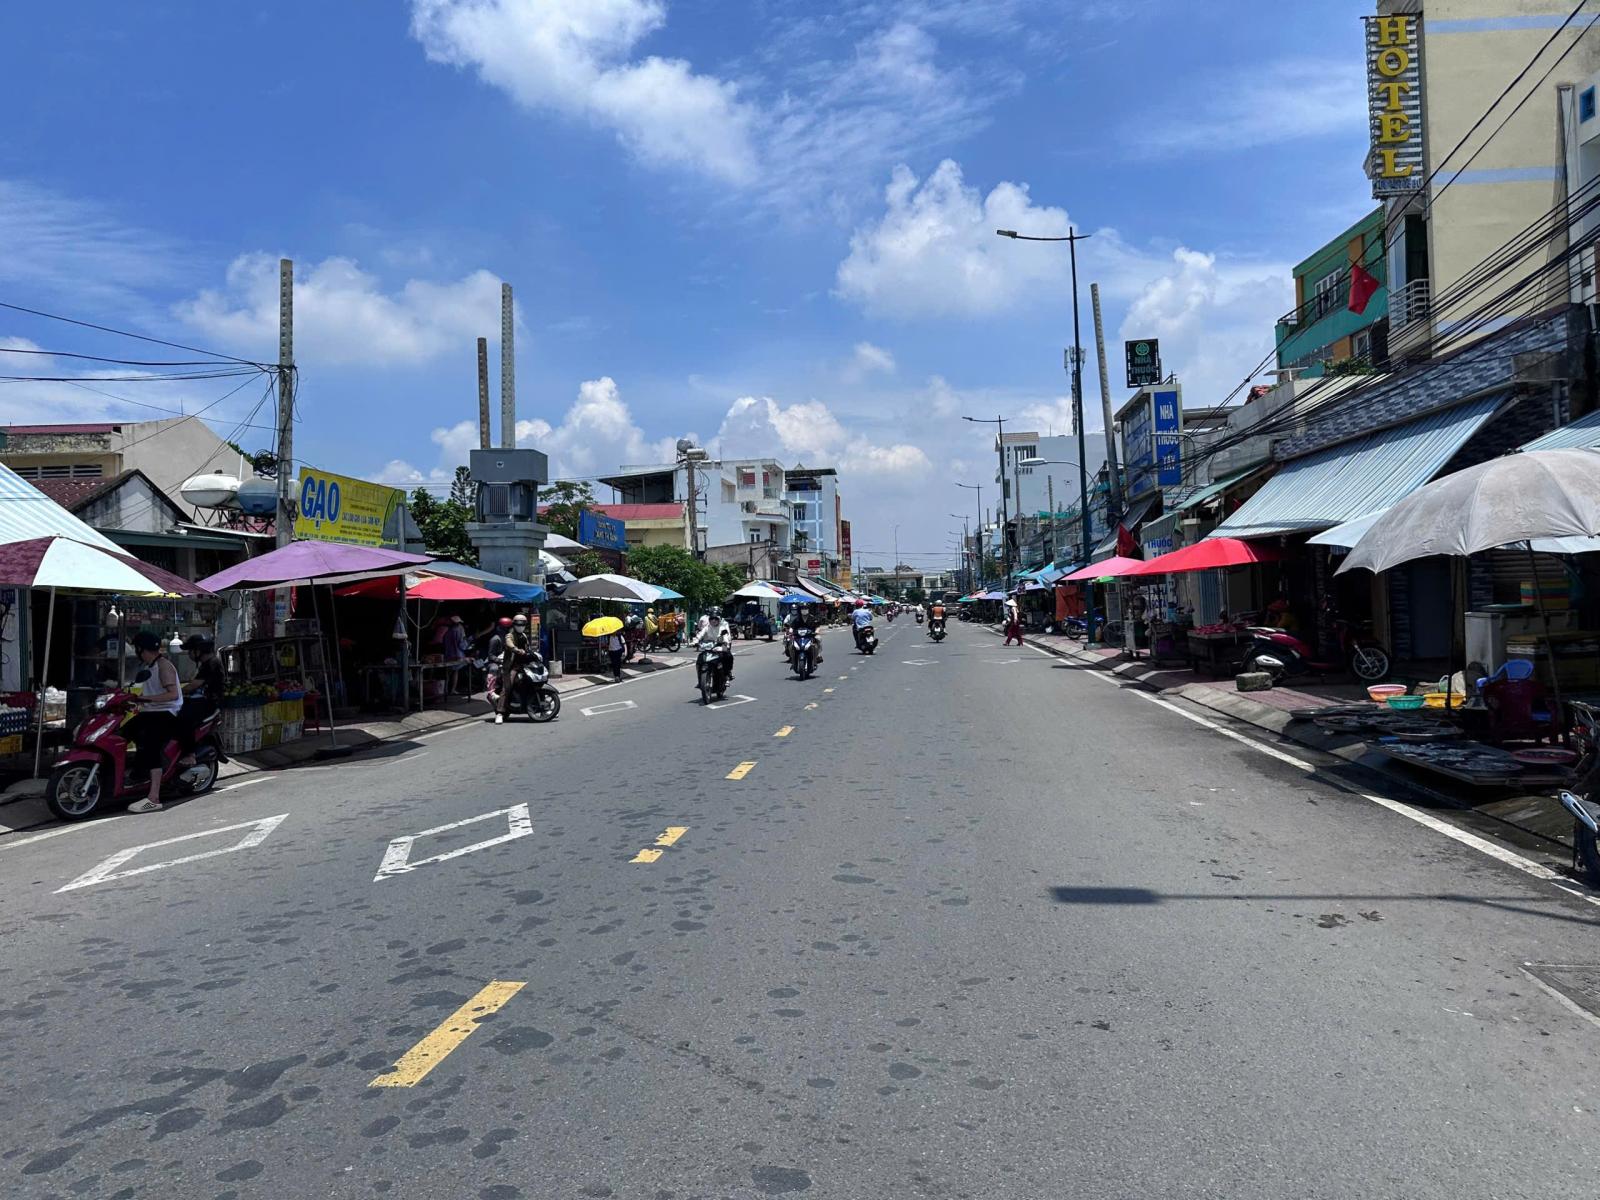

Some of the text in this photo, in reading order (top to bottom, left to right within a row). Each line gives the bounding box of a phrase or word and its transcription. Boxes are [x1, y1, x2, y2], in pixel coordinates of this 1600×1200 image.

[1376, 16, 1413, 178] HOTEL
[1134, 355, 1151, 364] NHÀ
[1159, 401, 1174, 420] NHÀ
[1157, 426, 1179, 445] THUỐC
[301, 476, 340, 529] GẠO
